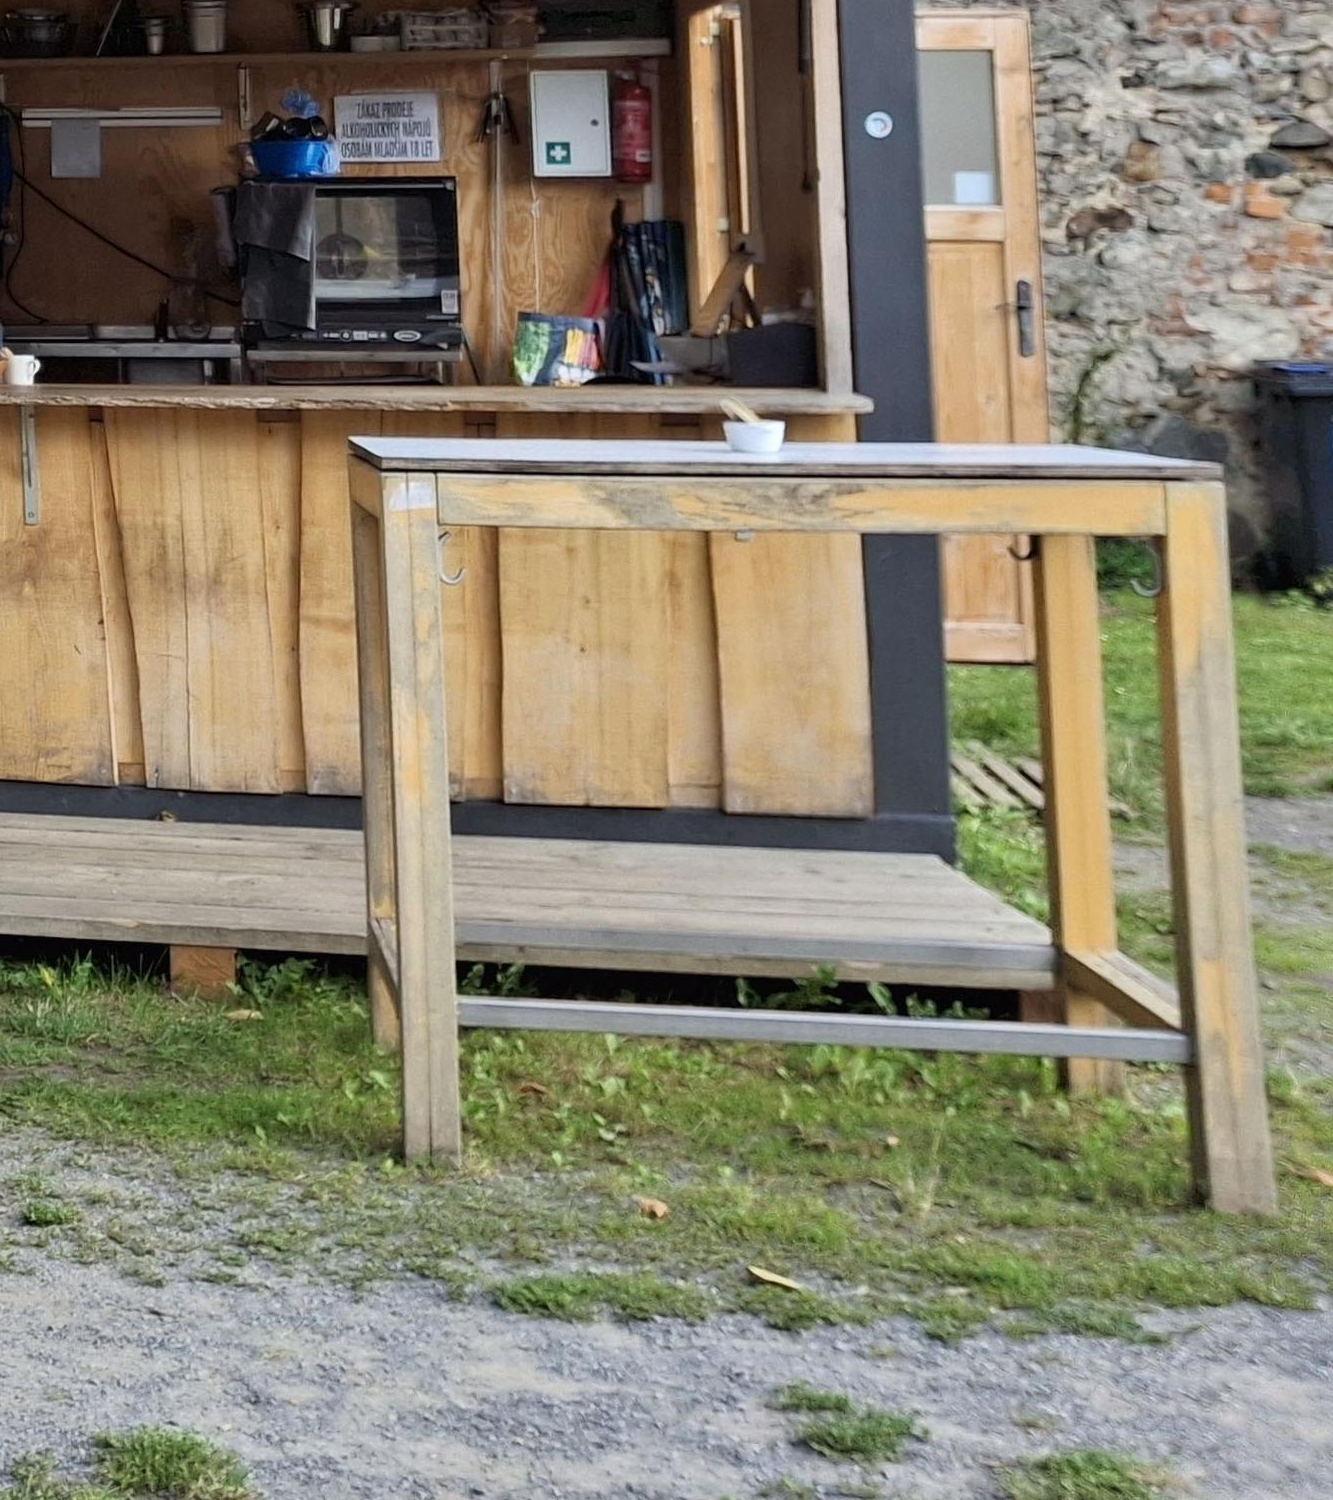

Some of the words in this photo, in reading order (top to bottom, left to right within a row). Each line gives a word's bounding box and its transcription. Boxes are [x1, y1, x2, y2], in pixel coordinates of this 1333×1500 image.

[356, 99, 381, 120] ZÁKAZ
[382, 100, 415, 118] PRODEJE
[402, 116, 432, 138] NÁPOJŮ
[421, 140, 434, 158] LET
